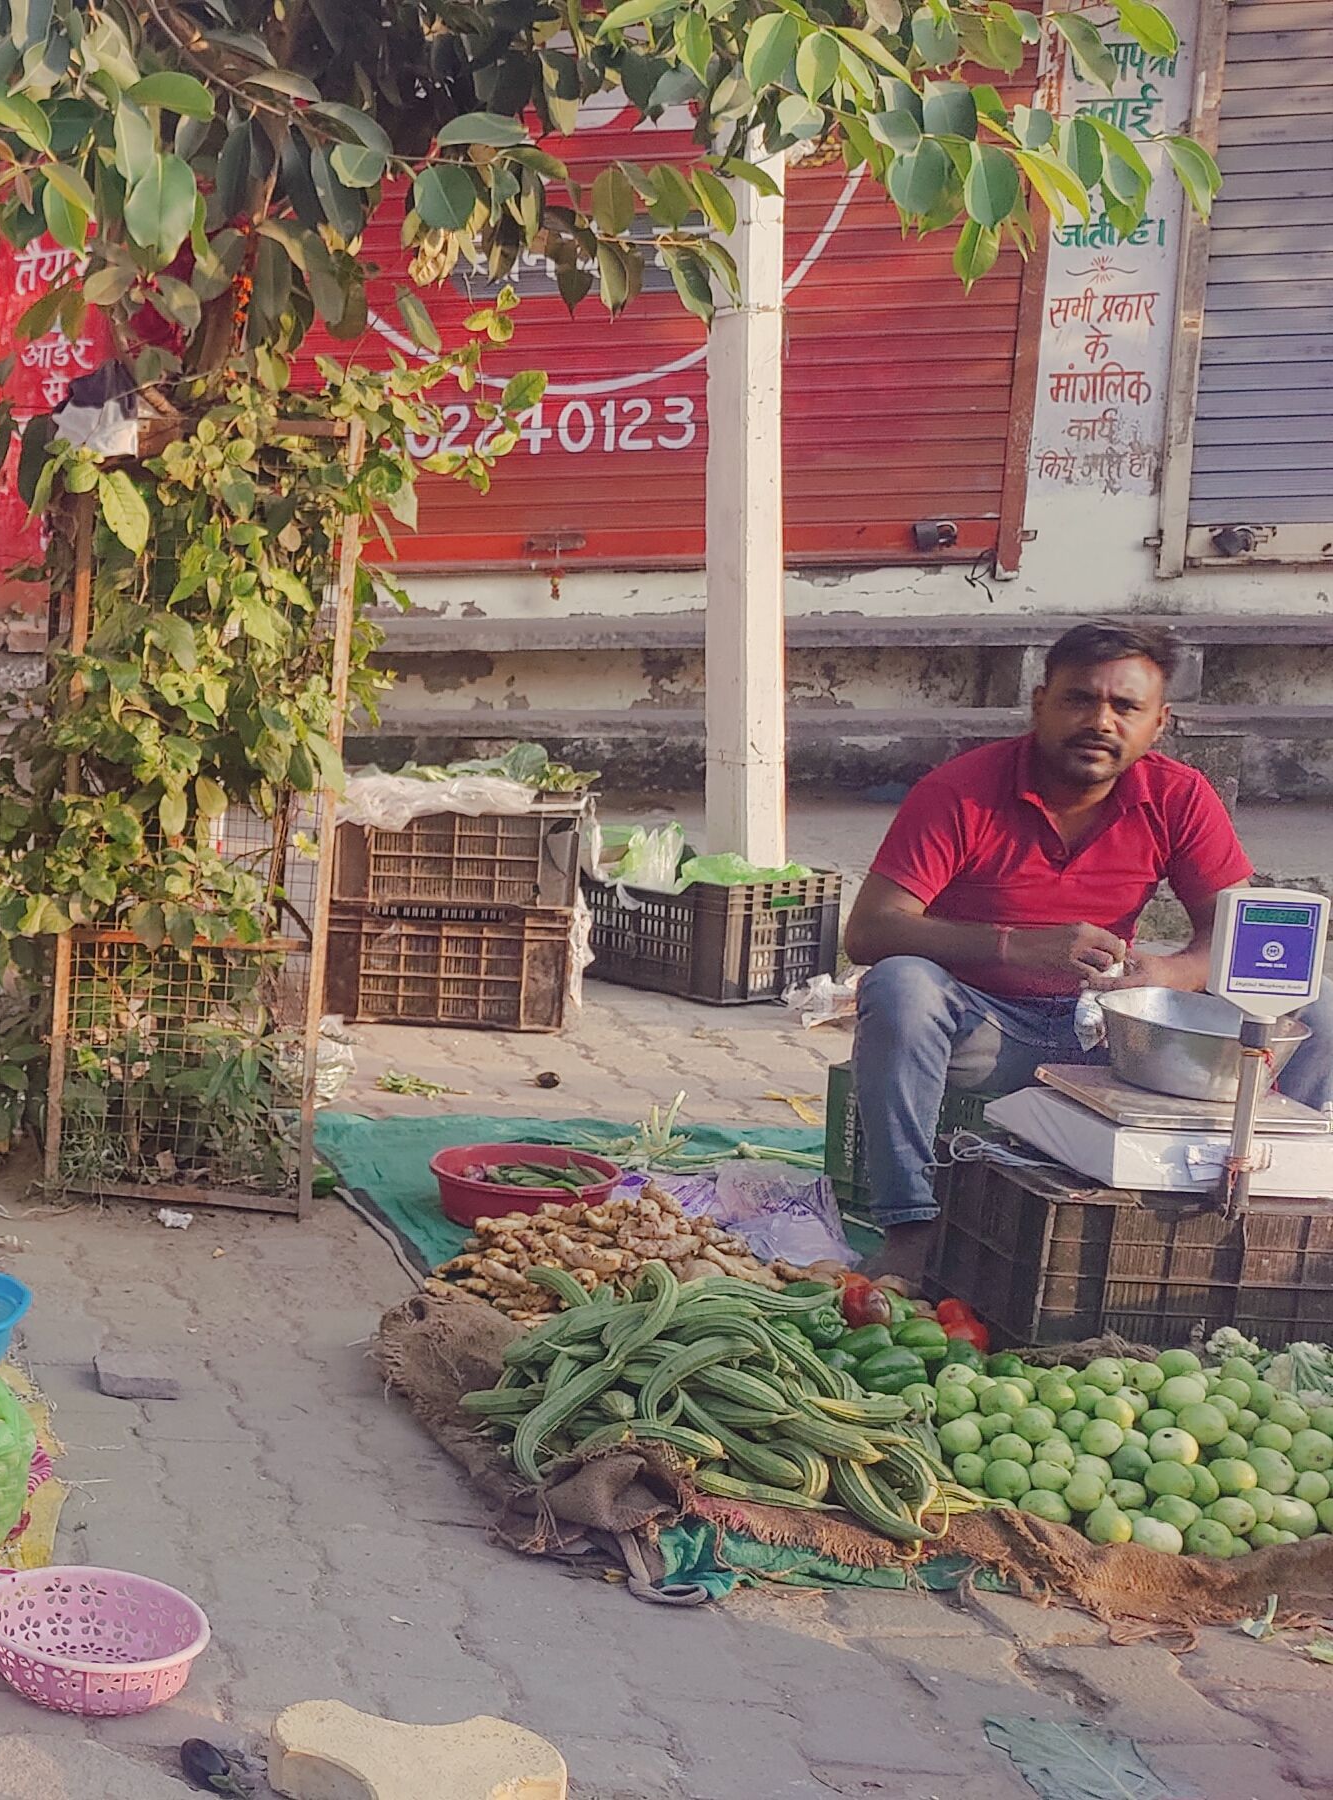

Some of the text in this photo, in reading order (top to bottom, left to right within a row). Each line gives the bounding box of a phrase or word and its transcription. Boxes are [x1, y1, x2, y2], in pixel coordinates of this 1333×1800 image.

[1050, 287, 1160, 328] सभी प्रकार
[1084, 325, 1112, 364] के
[1049, 362, 1152, 405] मांगलिक
[386, 397, 696, 459] 02240123
[1067, 408, 1118, 442] कार्य
